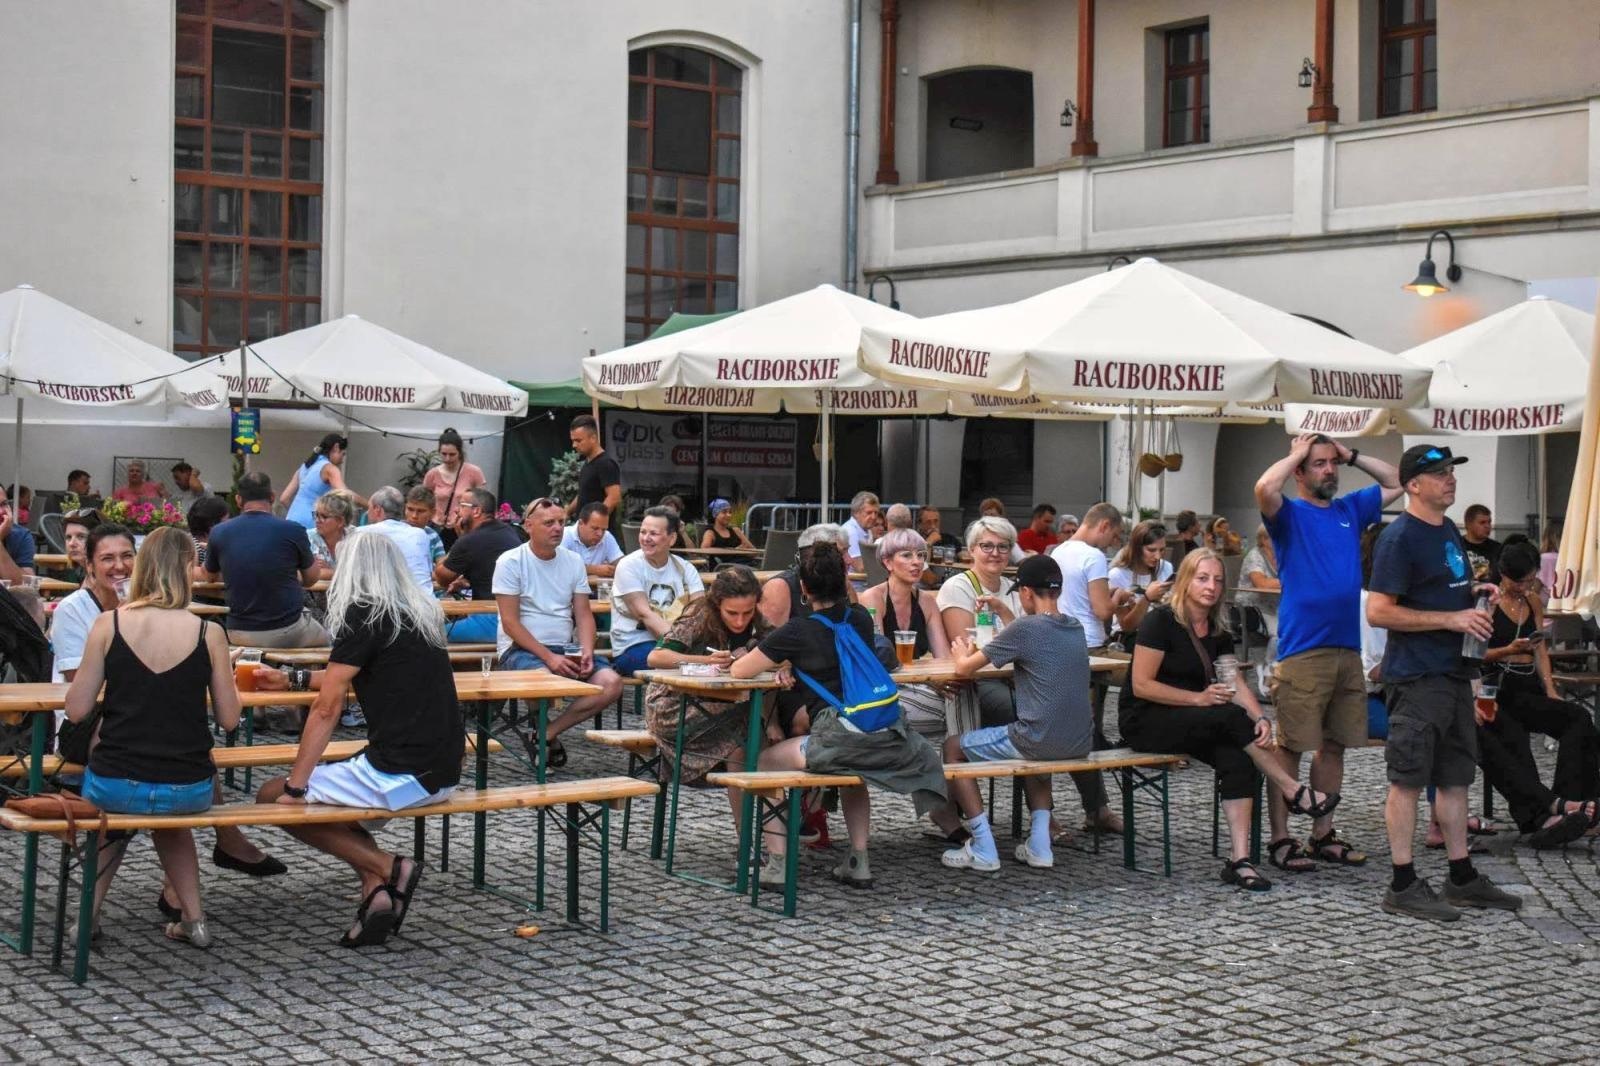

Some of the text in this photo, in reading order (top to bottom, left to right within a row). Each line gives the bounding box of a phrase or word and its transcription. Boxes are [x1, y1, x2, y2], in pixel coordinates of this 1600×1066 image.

[716, 358, 839, 381] RACIBORSKIE
[888, 338, 990, 378] RACIBORSKIE
[599, 359, 662, 385] RACIBORSKIE
[1072, 359, 1225, 392] RACIBORSKIE
[1310, 367, 1403, 399] RACIBORSKIE
[323, 382, 415, 403] RACIBORSKIE
[461, 391, 513, 412] RACIBORSKIE
[1300, 409, 1373, 432] RACIBORSKIE
[1432, 403, 1565, 431] RACIBORSKIE
[633, 423, 664, 444] DK
